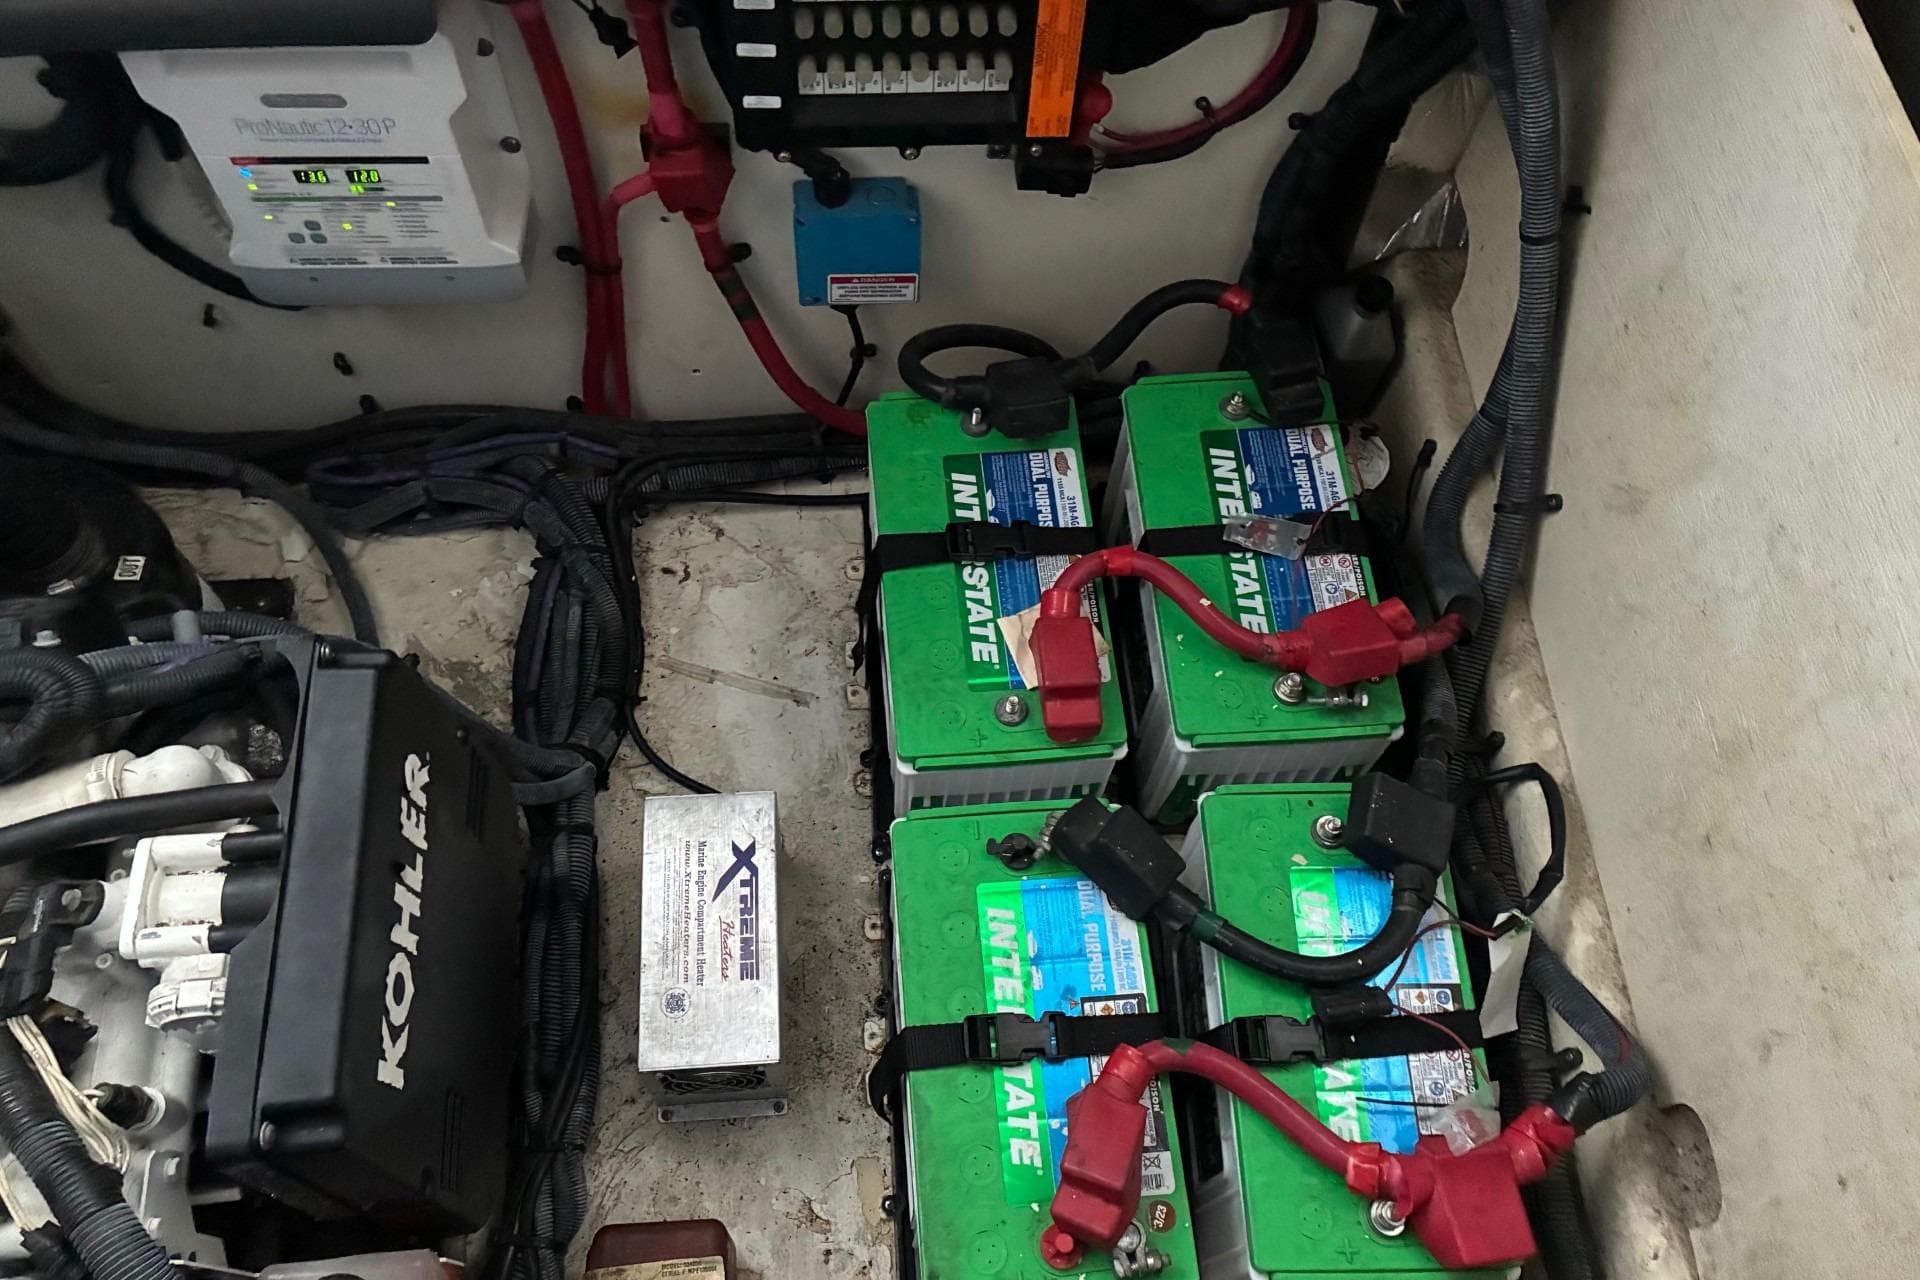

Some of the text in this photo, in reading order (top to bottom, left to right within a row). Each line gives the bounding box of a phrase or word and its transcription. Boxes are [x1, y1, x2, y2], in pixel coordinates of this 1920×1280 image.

[1029, 452, 1053, 527] DUAL PURPOS
[1285, 429, 1302, 458] DUAL
[1291, 459, 1316, 510] PURPOSE
[951, 472, 999, 663] INTSTATE
[1066, 496, 1079, 527] 31M-AG
[1209, 447, 1269, 634] INTETATE
[377, 753, 430, 1090] KOHLER
[683, 840, 692, 983] www.XtremeHeaters.com
[695, 840, 708, 987] Marine Engine Compartment Heater
[712, 840, 759, 981] XTREME
[719, 919, 735, 982] Heaters
[1077, 880, 1107, 991] DUAL PURPOSE
[986, 908, 1043, 1169] INTETATE
[1153, 1204, 1167, 1229] 3/23
